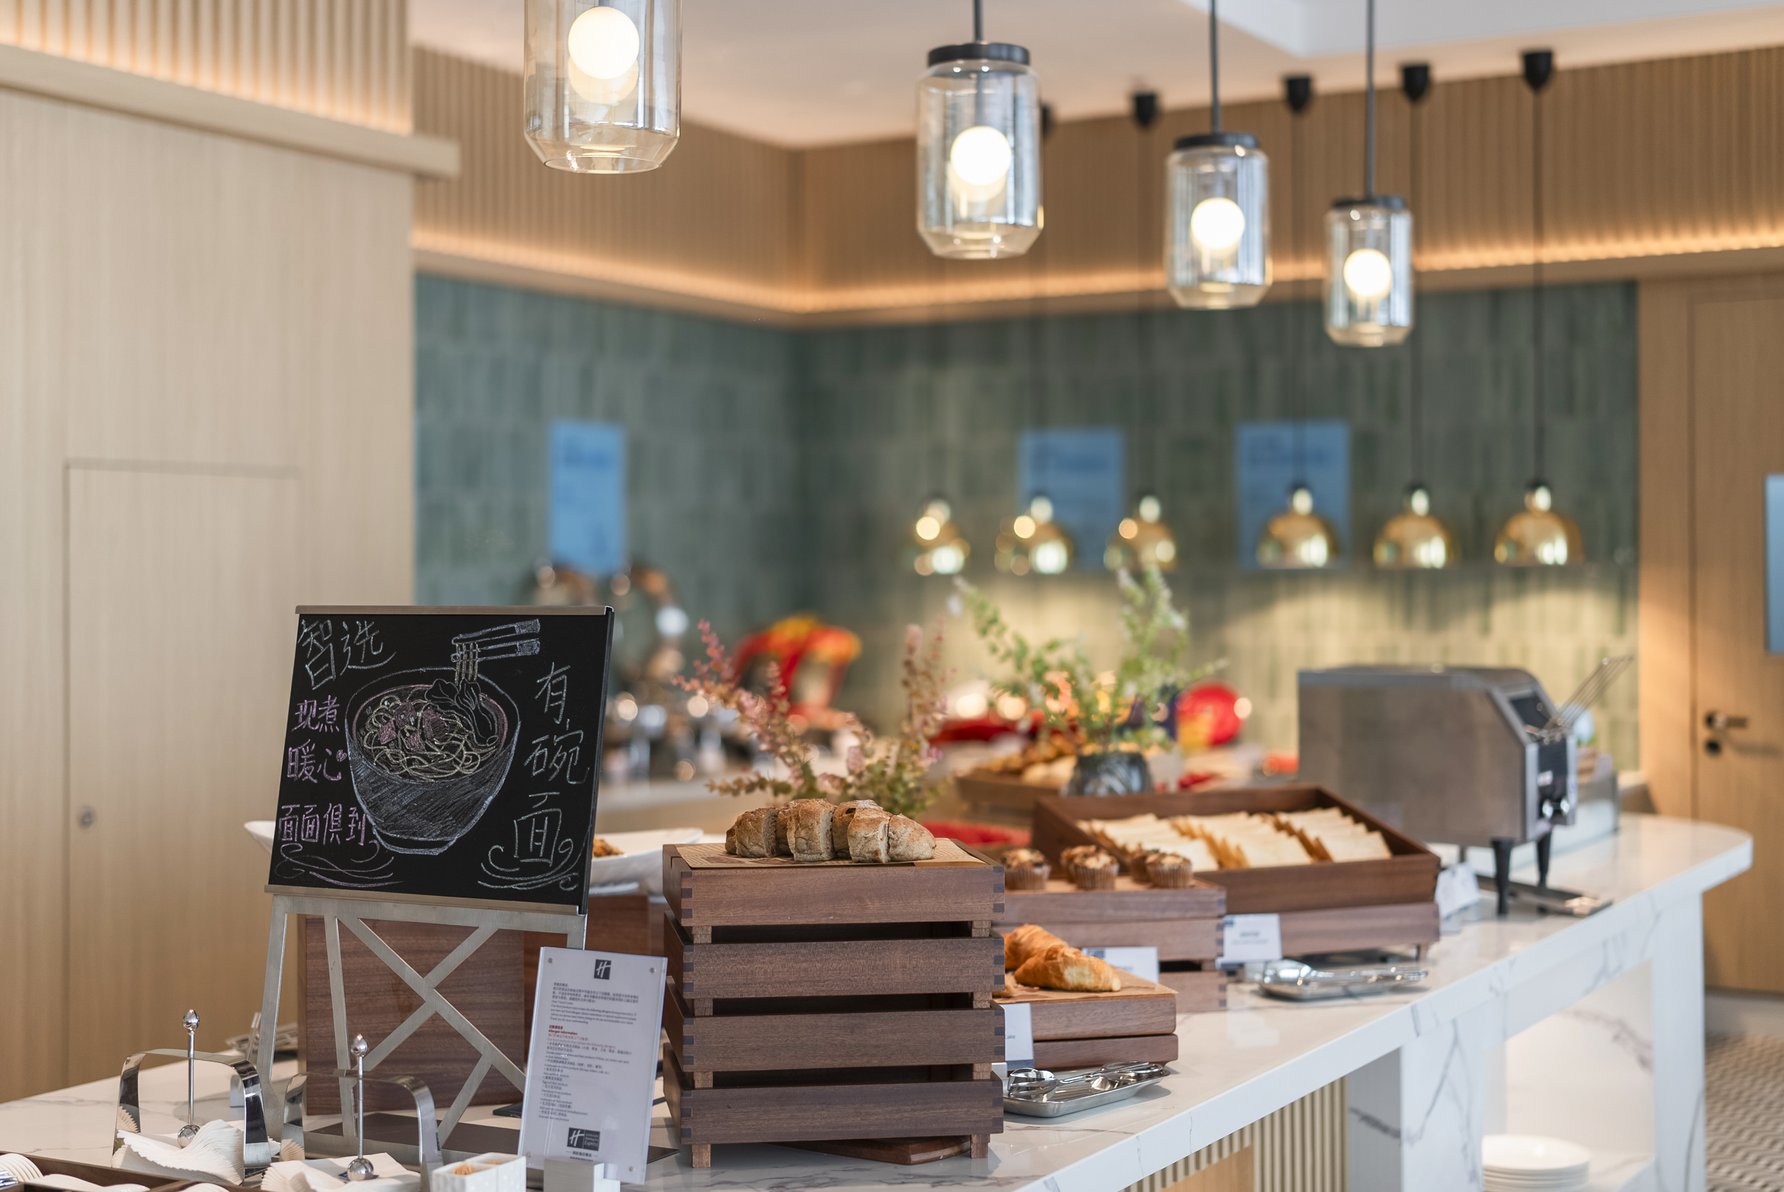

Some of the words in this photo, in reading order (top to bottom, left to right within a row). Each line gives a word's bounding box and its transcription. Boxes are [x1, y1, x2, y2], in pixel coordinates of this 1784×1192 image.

[297, 618, 397, 691] 智选
[291, 694, 341, 733] 现煮
[286, 738, 342, 784] 暖心
[514, 661, 590, 866] 有碗面
[279, 802, 367, 846] 面面俱到
